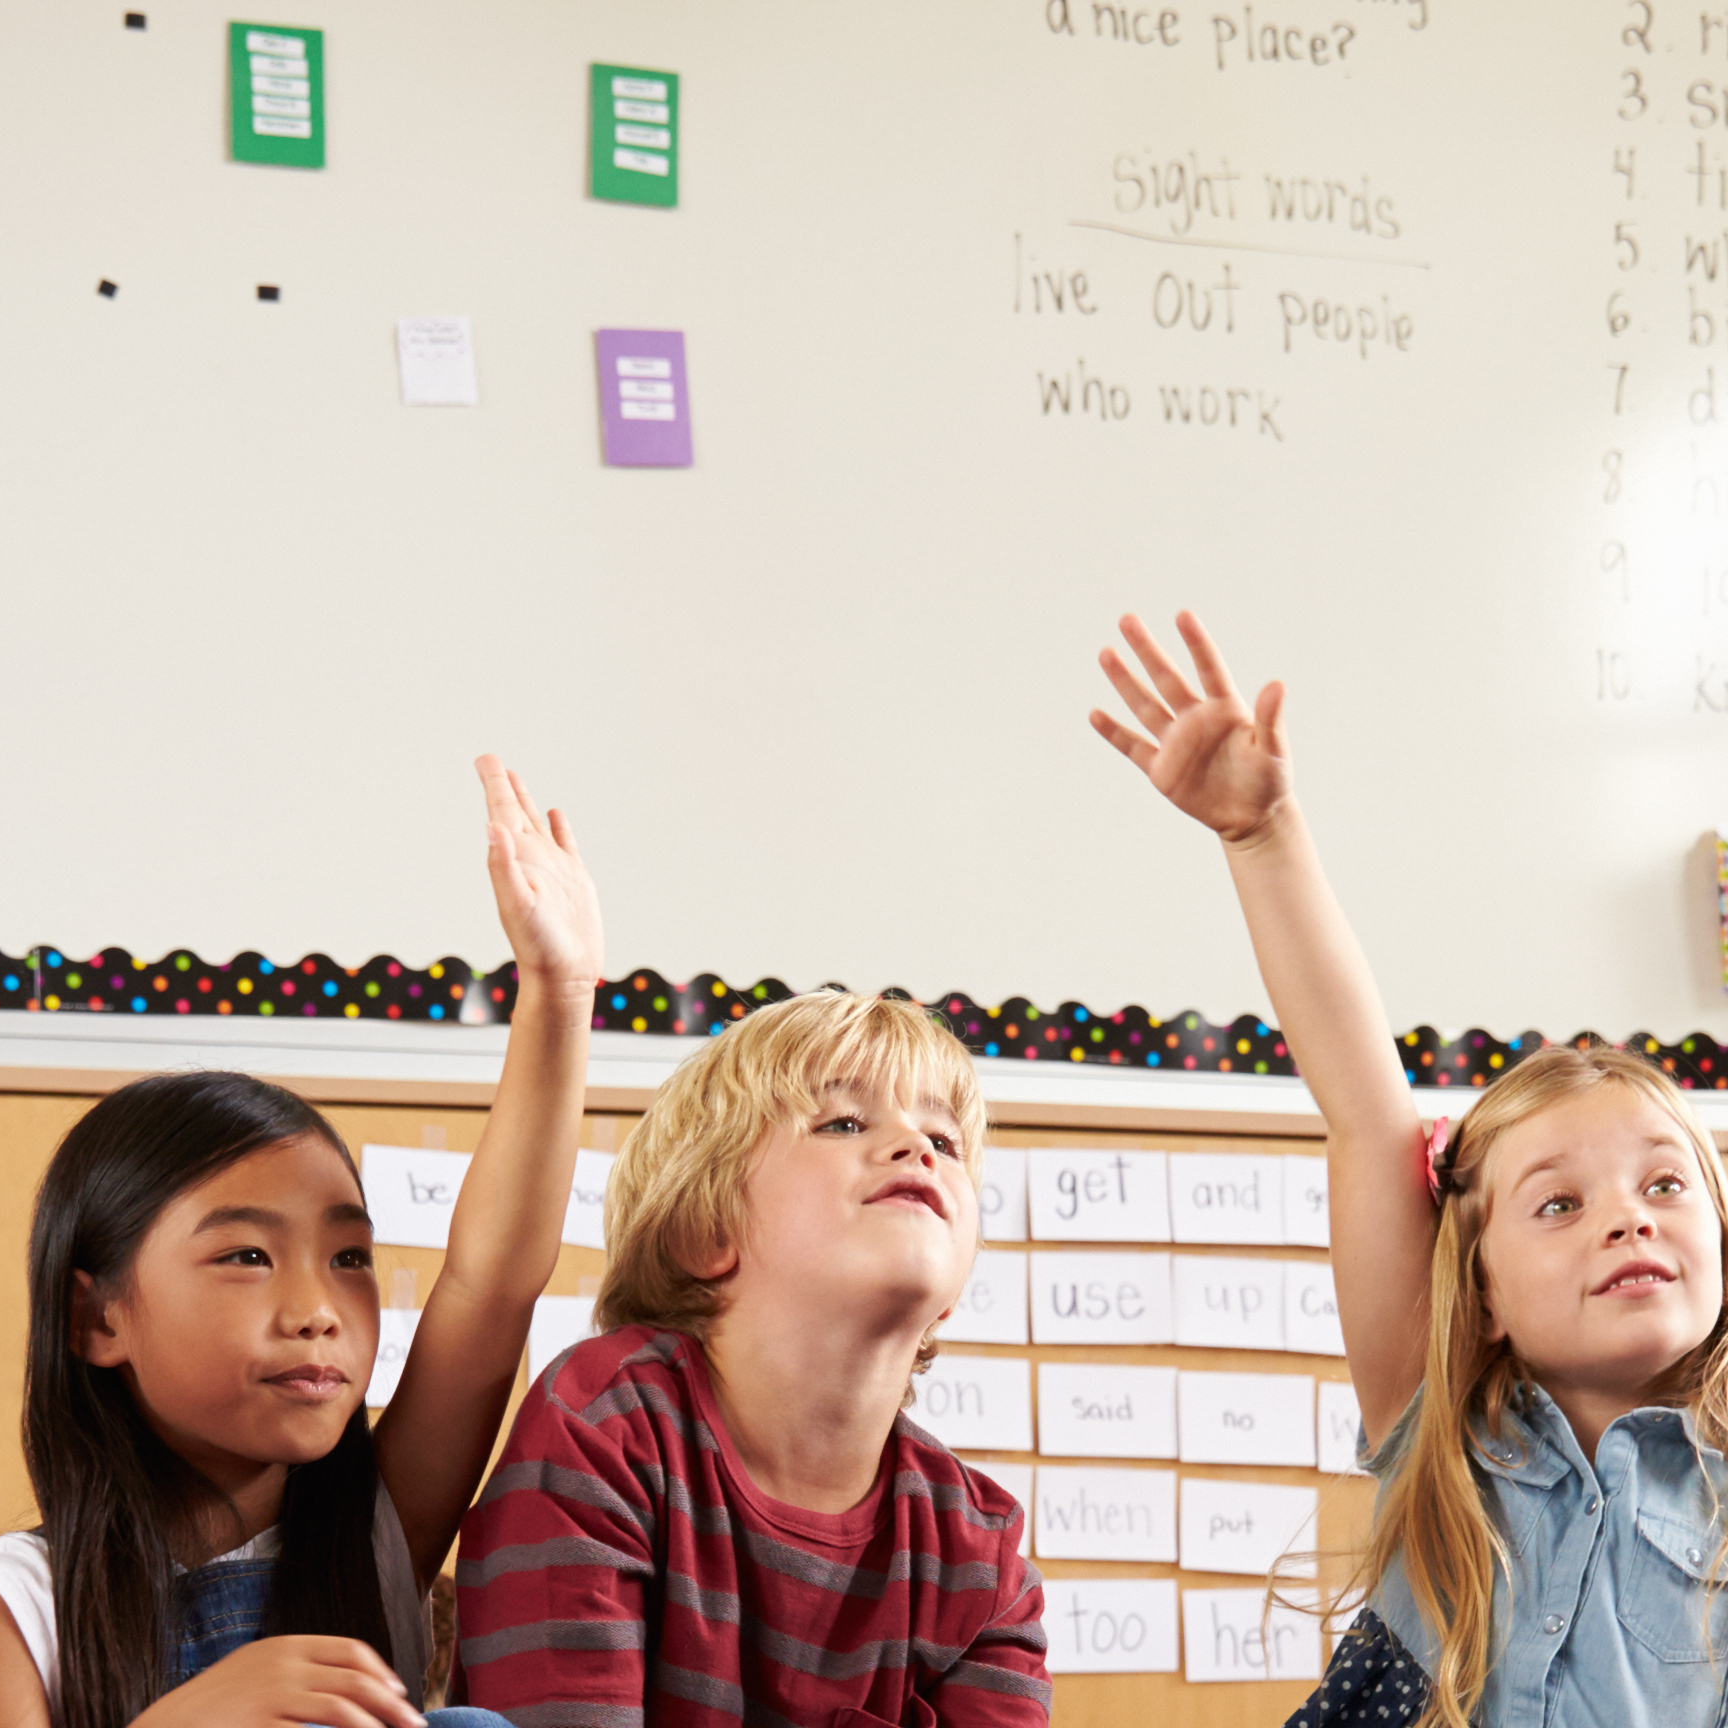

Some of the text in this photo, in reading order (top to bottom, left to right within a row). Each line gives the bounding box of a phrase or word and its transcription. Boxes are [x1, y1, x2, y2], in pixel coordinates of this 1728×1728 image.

[1092, 0, 1180, 46] nice
[1212, 6, 1356, 70] place?
[1113, 148, 1402, 241] Sight words
[1012, 232, 1100, 316] live
[1278, 290, 1415, 360] people
[1037, 357, 1284, 443] who work
[406, 1171, 454, 1205] be
[1054, 1154, 1134, 1220] get
[1191, 1169, 1262, 1213] and
[1051, 1280, 1146, 1321] use
[1203, 1284, 1264, 1323] up
[925, 1377, 984, 1418] on
[1221, 1407, 1256, 1431] no
[1041, 1487, 1155, 1538] when
[1207, 1515, 1256, 1542] put
[1064, 1592, 1148, 1655] too
[1210, 1600, 1300, 1668] her
